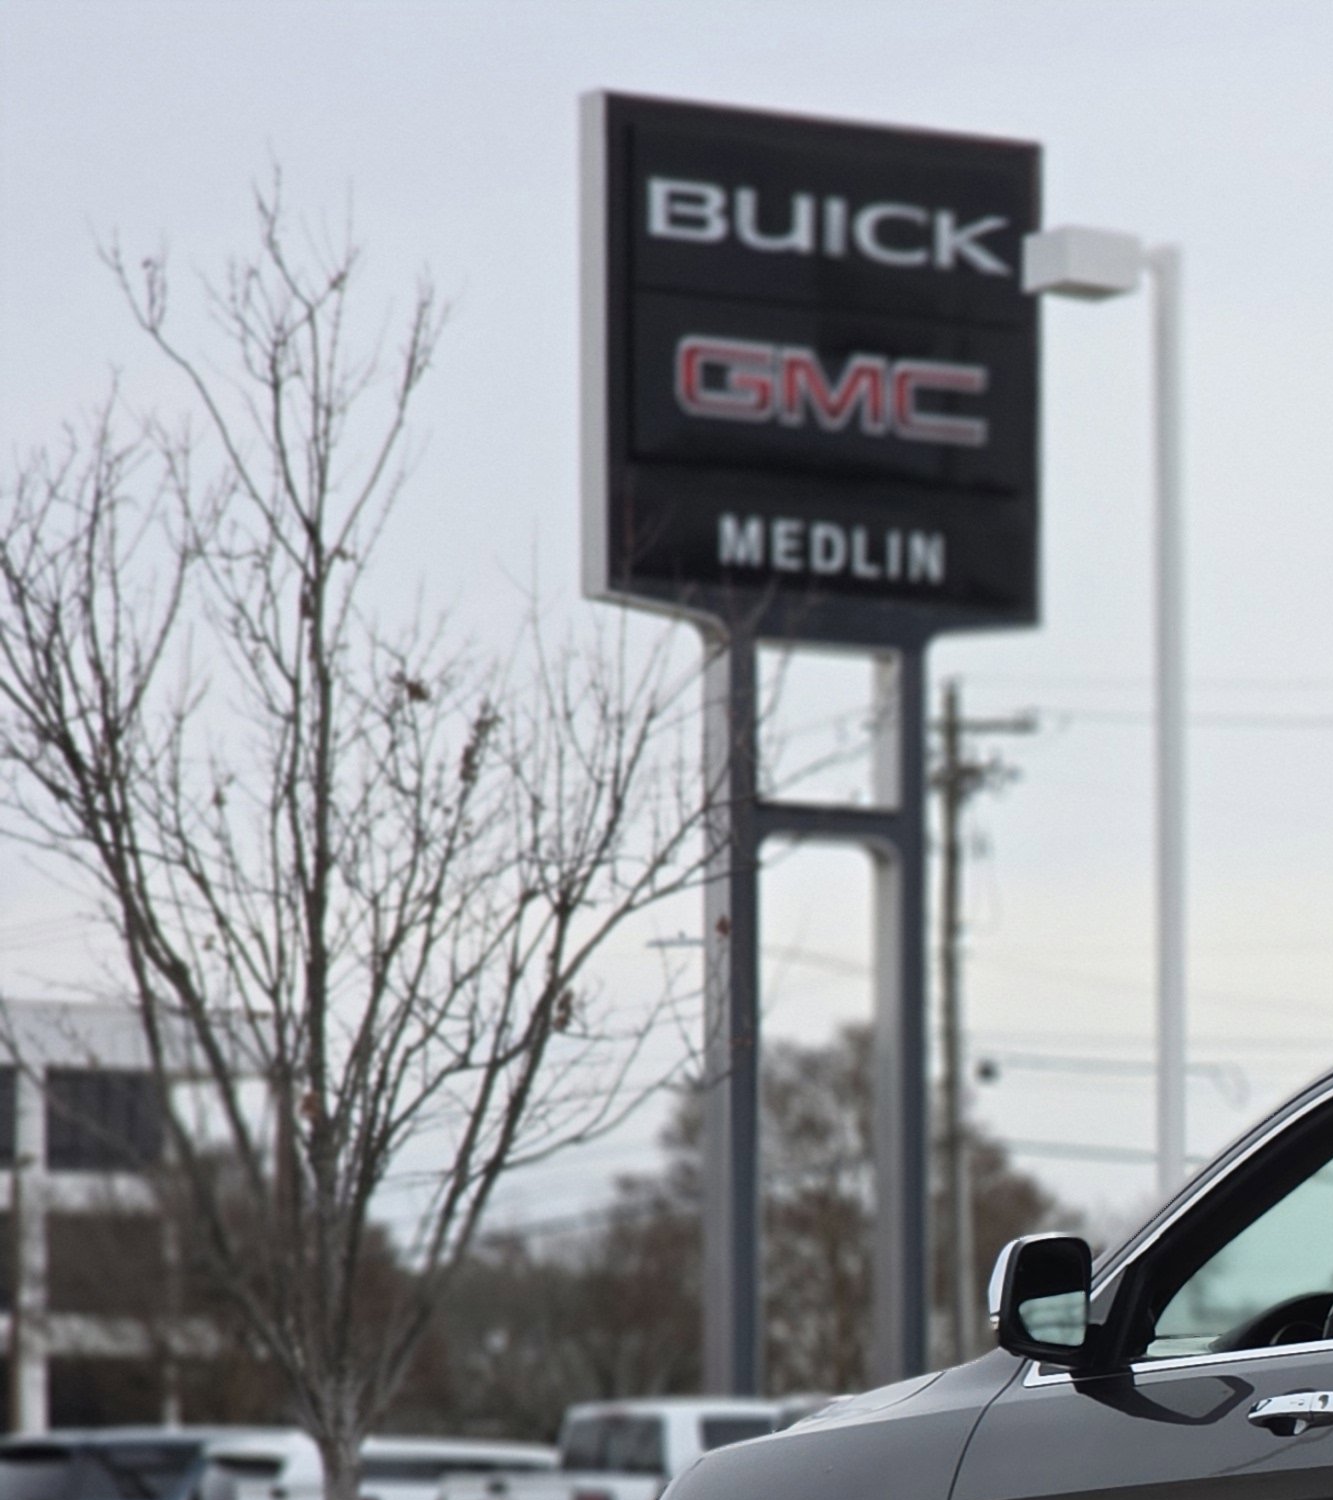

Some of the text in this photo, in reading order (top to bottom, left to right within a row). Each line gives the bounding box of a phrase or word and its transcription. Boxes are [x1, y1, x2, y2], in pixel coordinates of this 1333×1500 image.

[645, 175, 1012, 277] BUICK
[675, 333, 989, 448] GMC
[717, 512, 947, 584] MEDLIN
